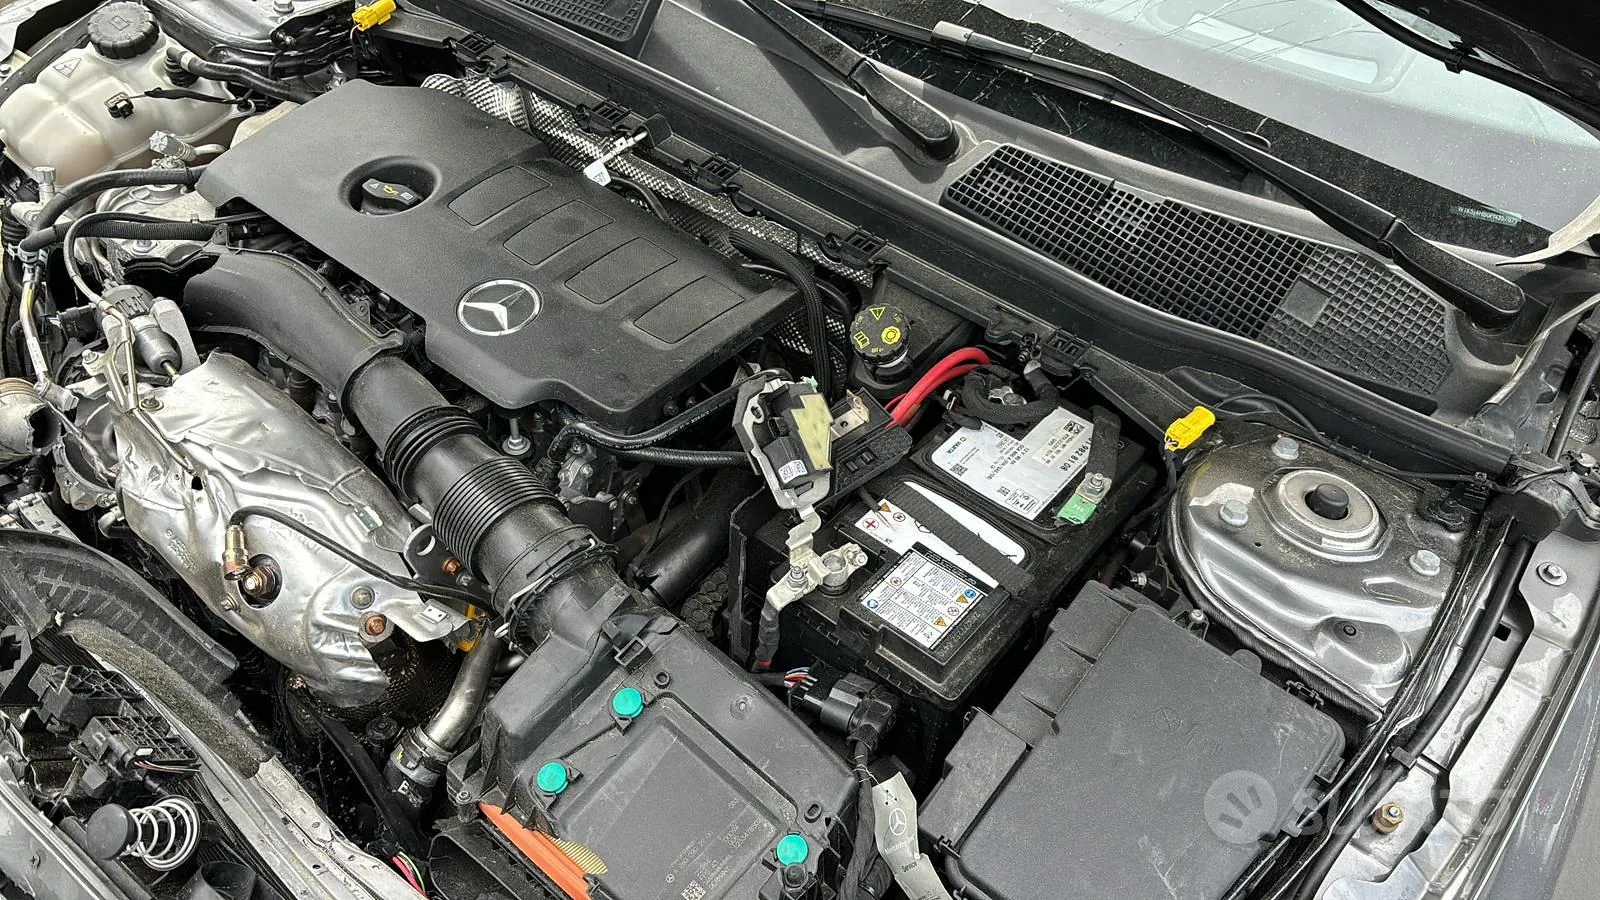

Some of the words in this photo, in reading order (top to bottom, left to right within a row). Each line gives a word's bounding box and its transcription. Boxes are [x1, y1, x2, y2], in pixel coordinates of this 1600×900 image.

[946, 440, 961, 455] VARTA
[1075, 445, 1088, 456] 982
[902, 861, 917, 872] Service
